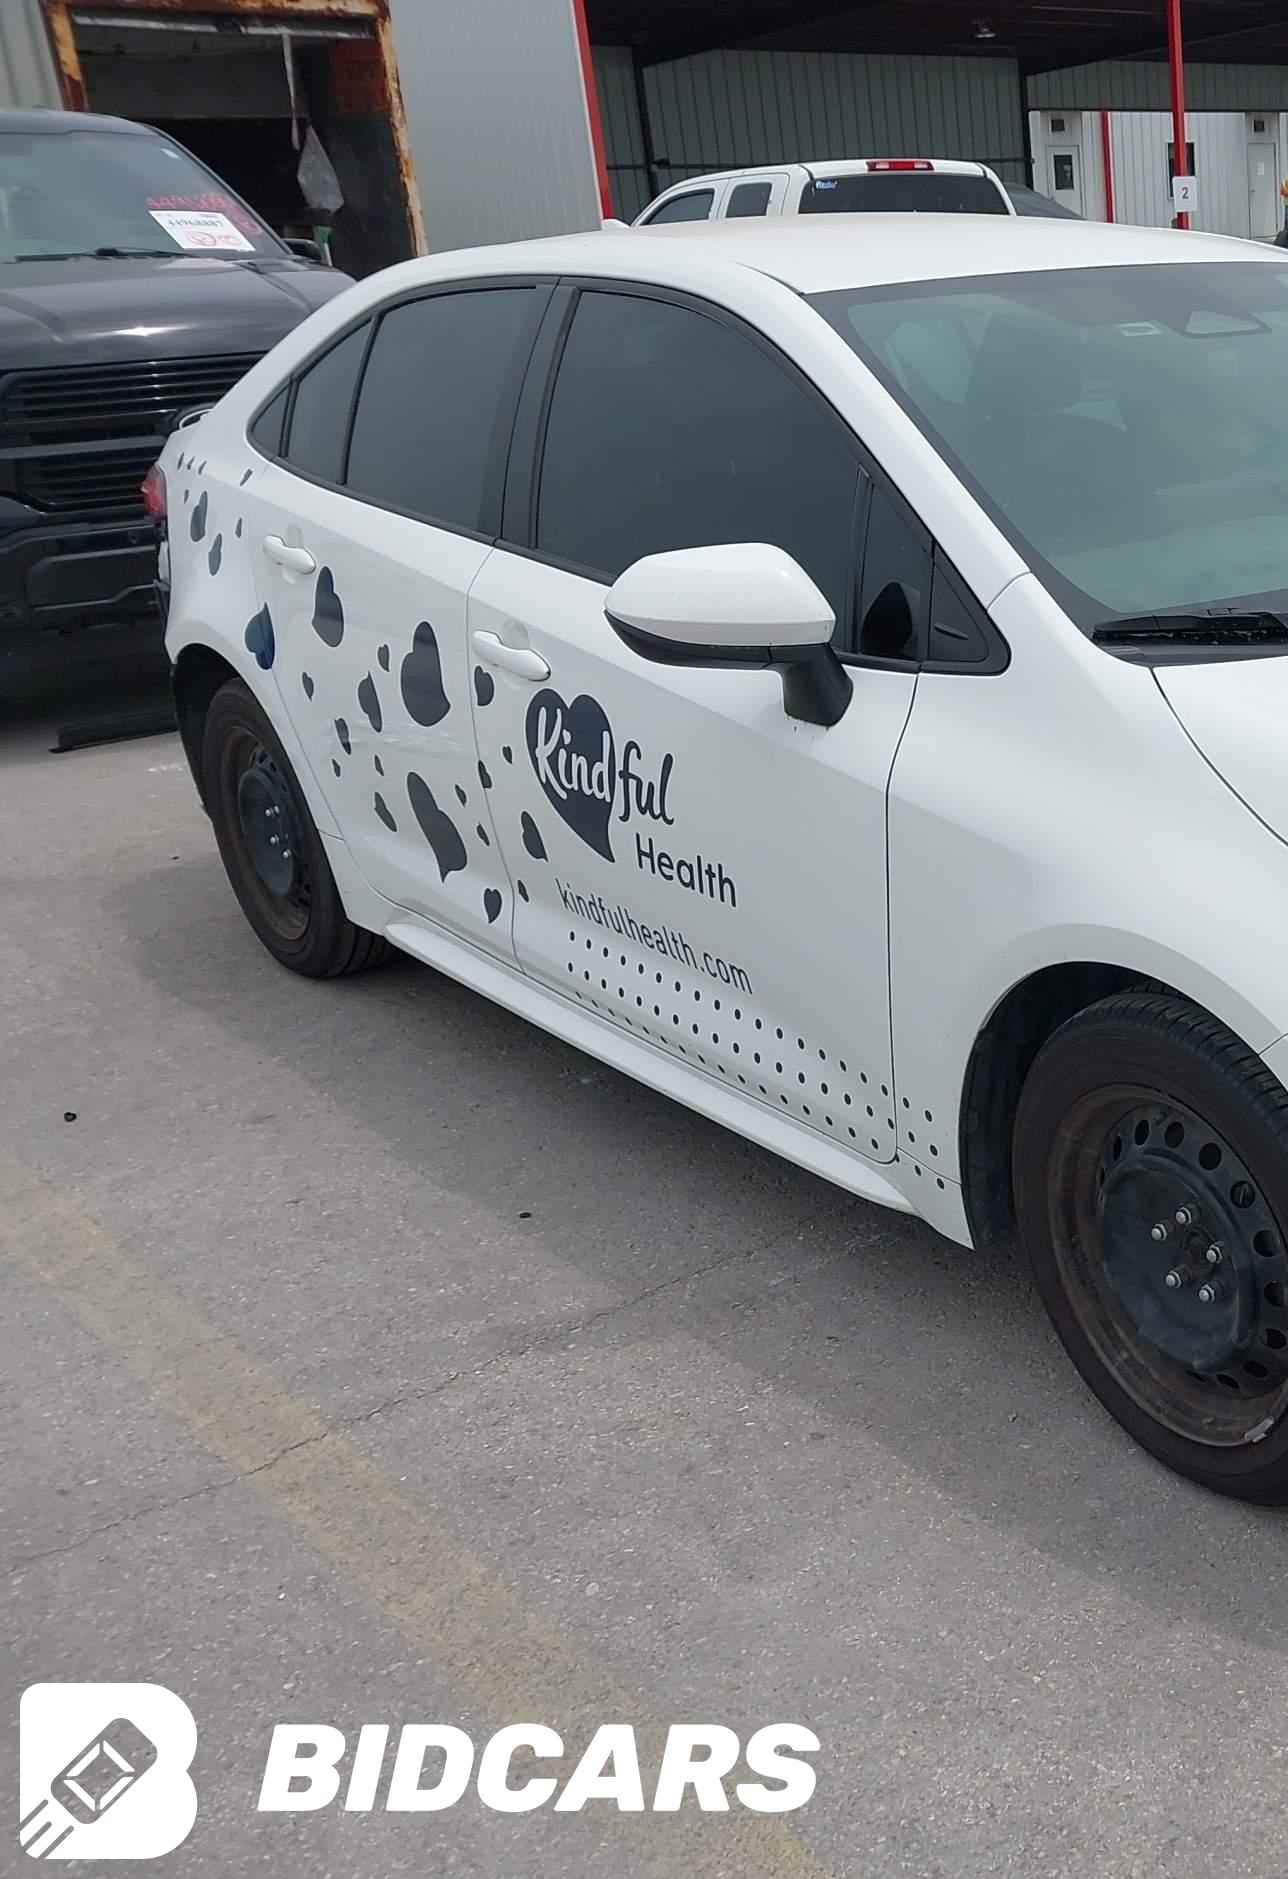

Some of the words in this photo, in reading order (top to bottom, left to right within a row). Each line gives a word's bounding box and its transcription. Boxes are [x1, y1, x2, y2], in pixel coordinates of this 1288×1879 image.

[1181, 186, 1190, 200] 2
[535, 705, 675, 826] Kindful
[635, 832, 737, 908] Health
[555, 877, 753, 995] kindfulhealth.com
